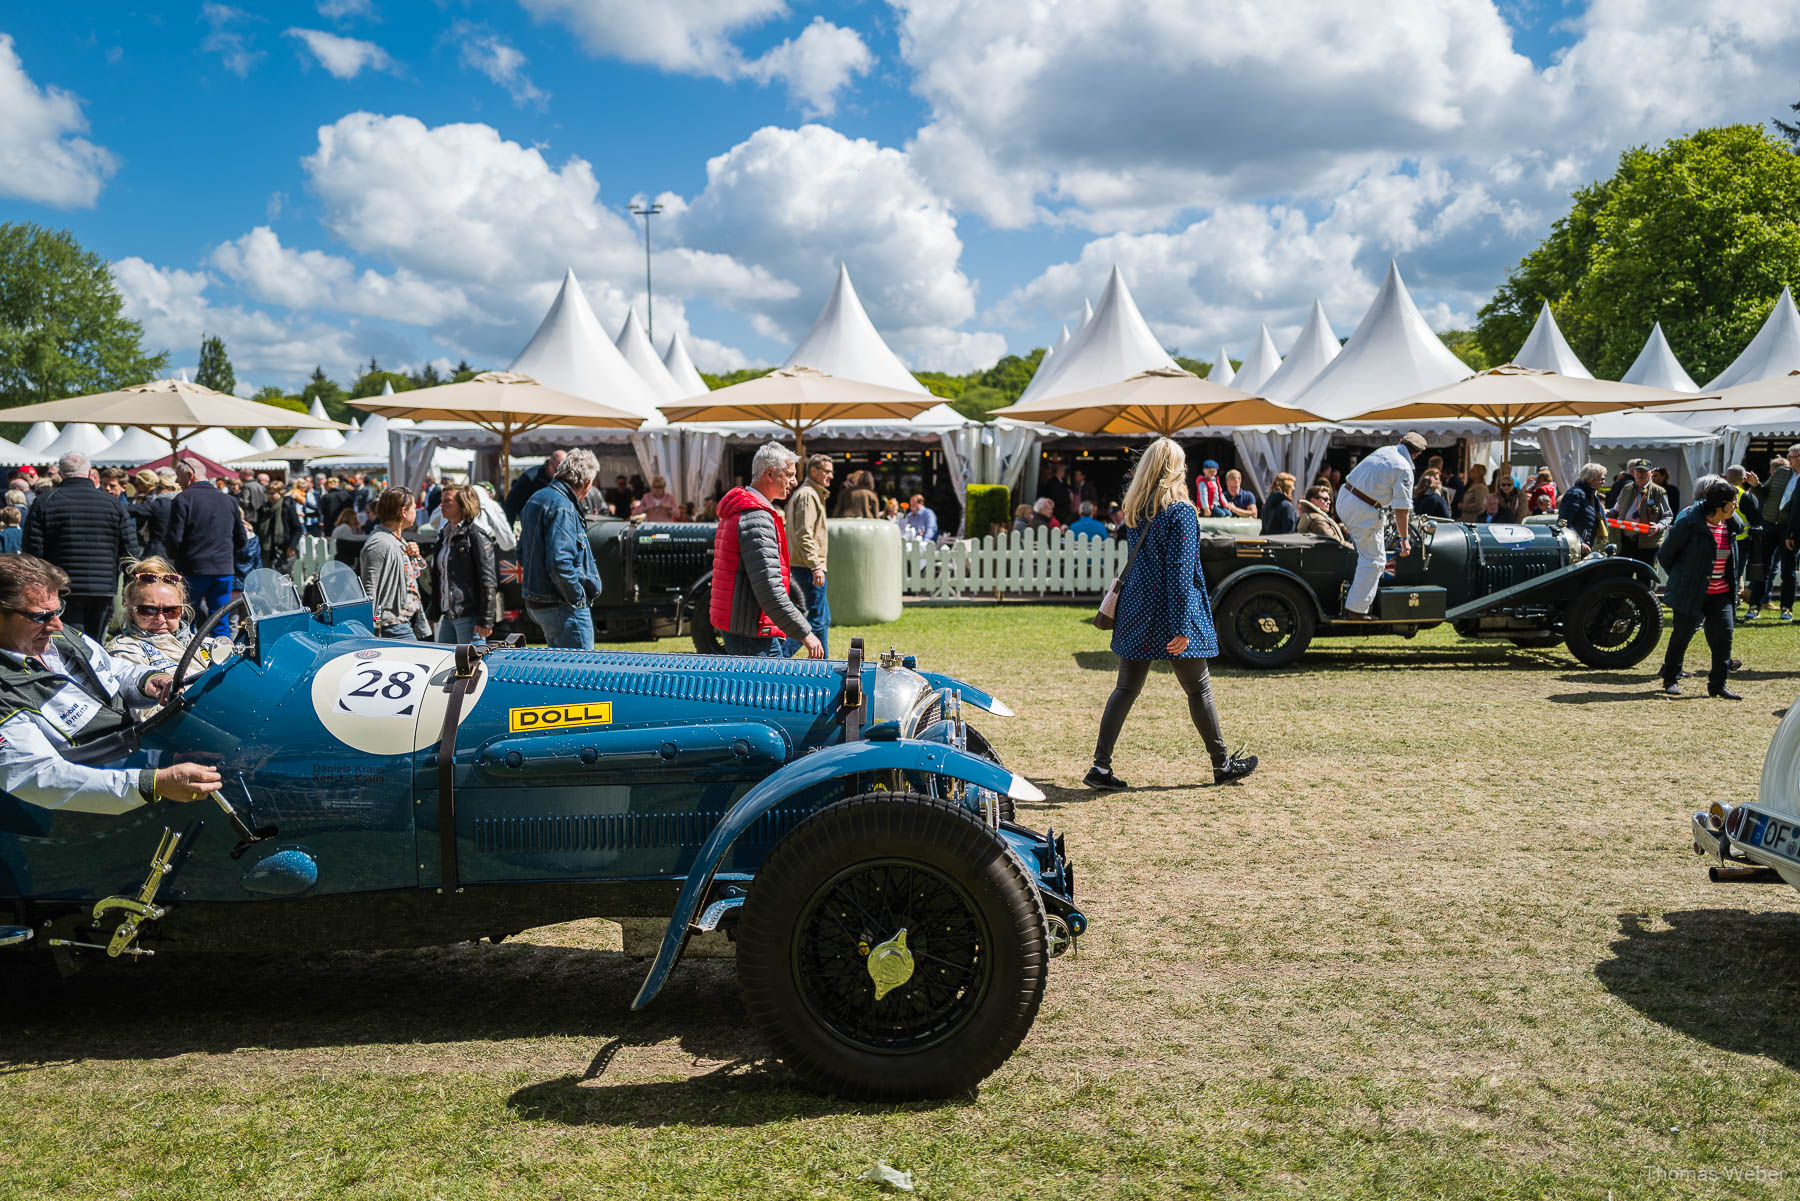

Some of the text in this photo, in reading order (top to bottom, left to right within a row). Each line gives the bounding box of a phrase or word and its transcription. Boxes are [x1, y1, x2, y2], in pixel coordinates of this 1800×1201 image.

[1504, 527, 1514, 536] 7
[347, 669, 415, 699] 28
[520, 707, 602, 726] DOLL
[313, 763, 385, 774] Daniela Kraus
[1764, 821, 1791, 848] OF
